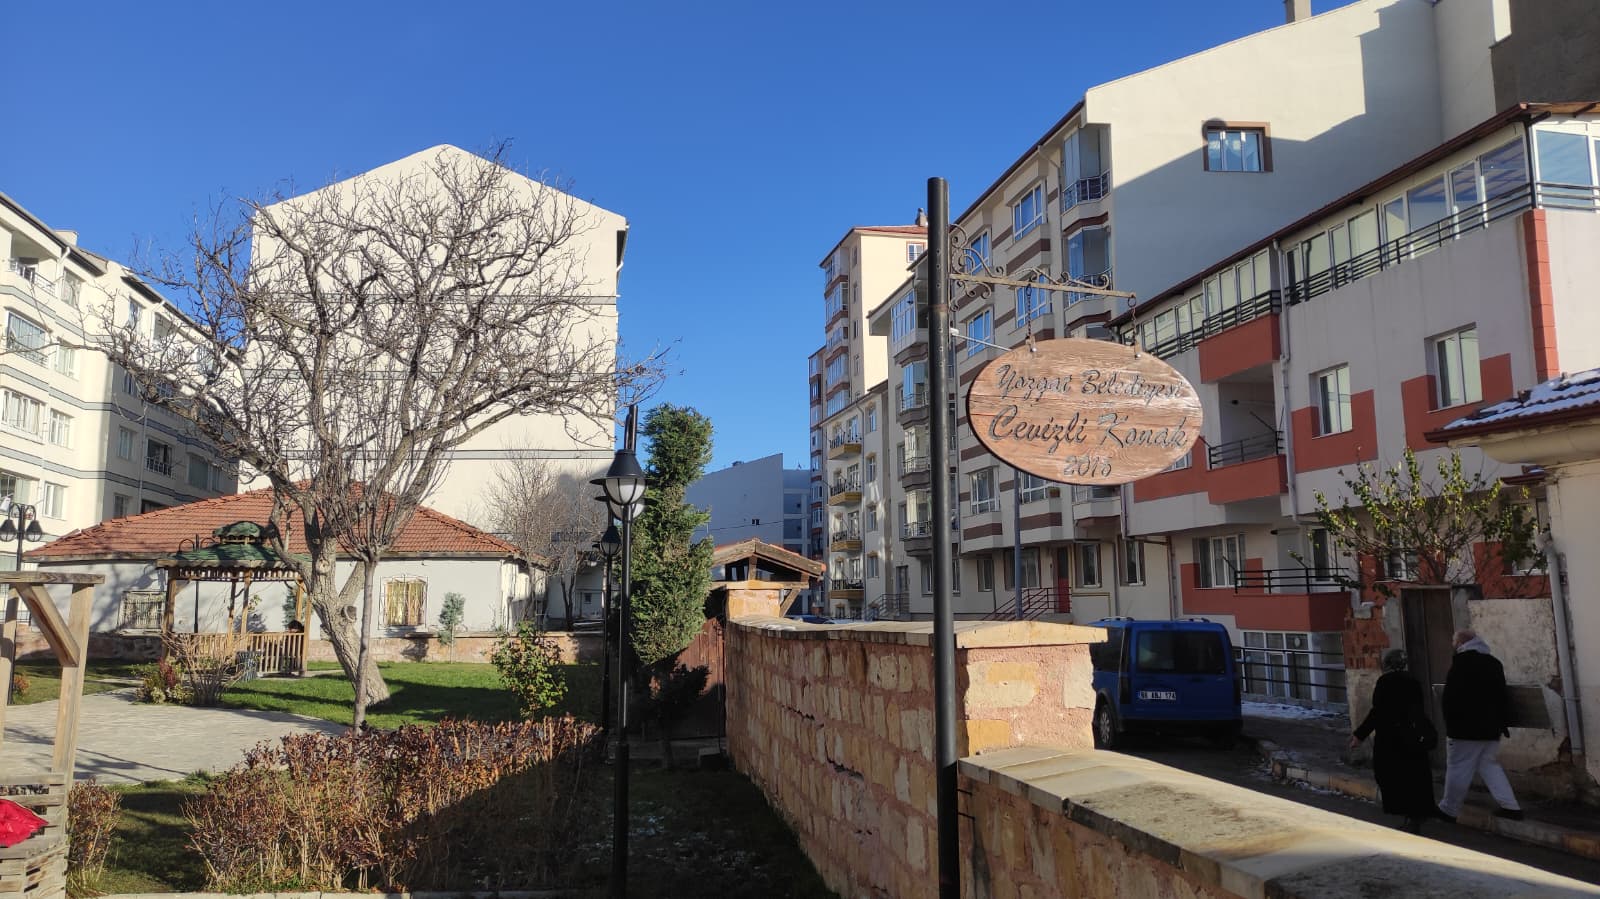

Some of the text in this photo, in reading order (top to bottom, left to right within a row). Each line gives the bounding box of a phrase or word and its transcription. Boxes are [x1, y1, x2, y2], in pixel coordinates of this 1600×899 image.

[996, 363, 1184, 405] Yozgat Belediyesi
[989, 404, 1188, 455] Cevizli Konak
